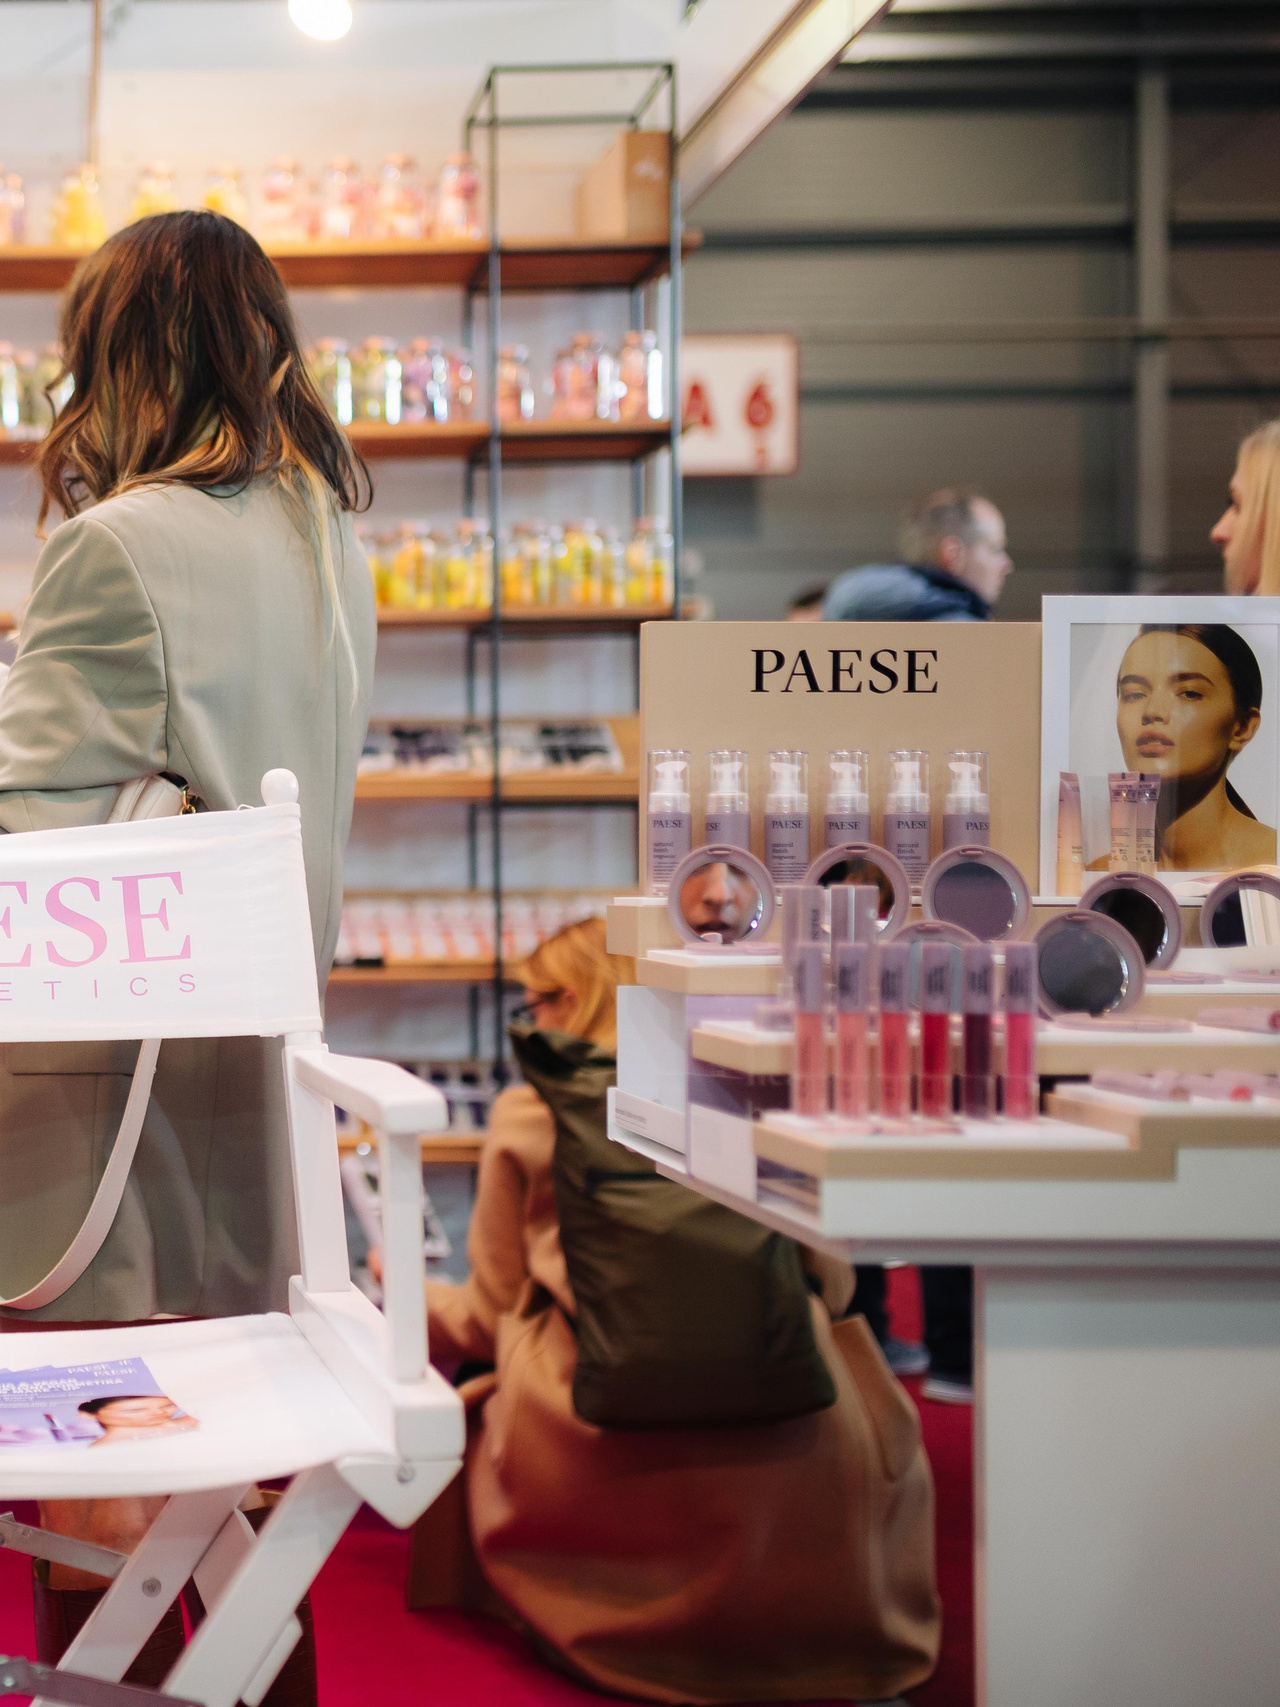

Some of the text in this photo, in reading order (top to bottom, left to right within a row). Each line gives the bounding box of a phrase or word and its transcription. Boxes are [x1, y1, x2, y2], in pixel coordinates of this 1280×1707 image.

[751, 648, 938, 694] PAESE
[653, 819, 684, 829] PAESE
[706, 821, 721, 831] ESE
[771, 820, 804, 829] PAESE
[828, 821, 861, 830] PAESE
[966, 821, 990, 831] PAES
